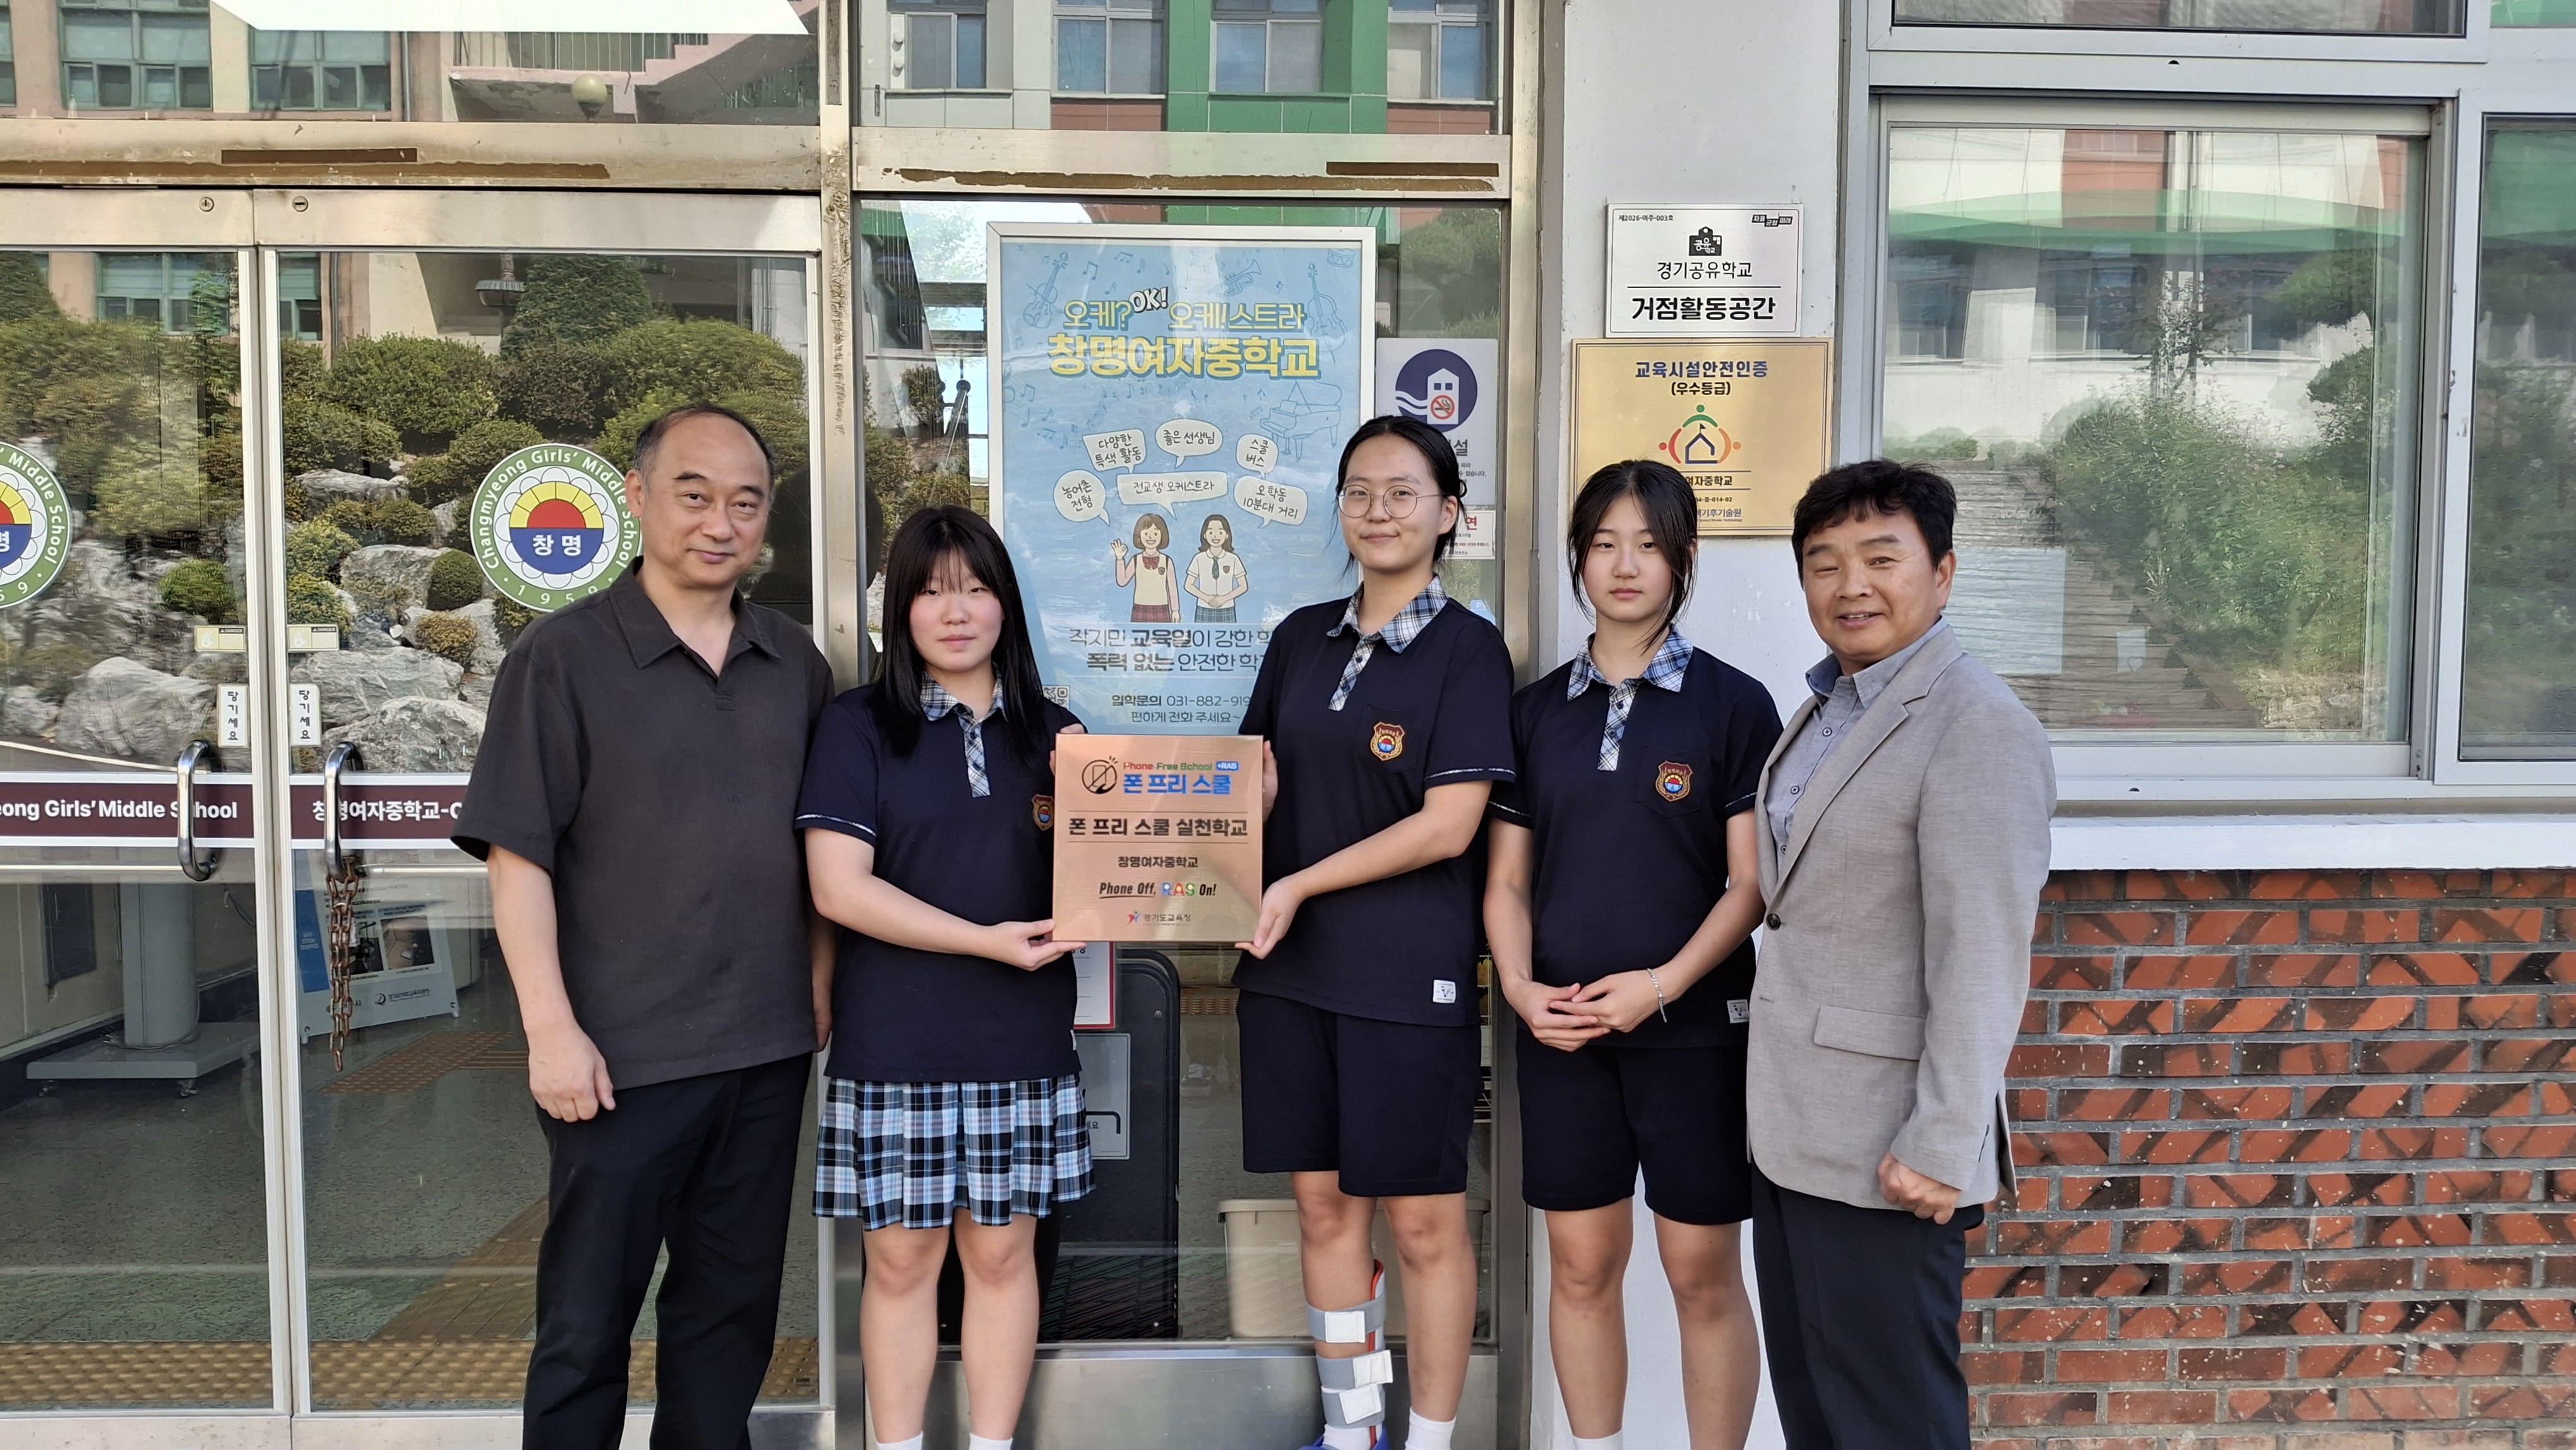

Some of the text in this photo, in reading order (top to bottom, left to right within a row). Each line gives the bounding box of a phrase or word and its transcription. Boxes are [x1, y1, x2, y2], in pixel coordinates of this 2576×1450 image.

[1693, 237, 1711, 251] 공유
[1656, 261, 1753, 280] 경기공유학교
[1063, 300, 1133, 330] 오케?
[1128, 286, 1169, 313] OK!
[1631, 297, 1776, 320] 거점활동공간
[1048, 332, 1320, 378] 창명여자중학교
[1635, 361, 1768, 378] 교육시설안전인증
[1671, 381, 1731, 396] (우수등급)
[1098, 433, 1132, 449] 다양한
[1163, 429, 1215, 446] 좋은 선생님
[1249, 439, 1269, 455] 스쿨
[1448, 439, 1468, 457] 설
[1095, 446, 1142, 468] 특색 활동
[1246, 453, 1265, 467] 버스
[1062, 479, 1092, 499] 농어촌
[1133, 480, 1215, 494] 전교생 오케스트라
[8, 452, 66, 564] Middle School
[1071, 494, 1093, 512] 전형
[1243, 497, 1298, 519] 10분대 거리
[479, 458, 528, 569] Changmyeong
[581, 456, 626, 505] Middle
[1069, 628, 1126, 647] 작지만
[1215, 629, 1254, 648] 강한
[1087, 652, 1265, 672] 폭력 없는 안전한 학
[1112, 695, 1162, 707] 입학문의
[227, 691, 239, 741] 당기세요
[298, 690, 311, 740] 당기세요
[1131, 712, 1166, 723] 편하게
[1168, 712, 1193, 723] 전화
[1123, 762, 1153, 770] Phone
[1156, 762, 1178, 770] Free
[1180, 762, 1212, 770] School
[1123, 774, 1231, 794] 폰 프리 스쿨
[98, 800, 165, 818] Middle
[170, 801, 237, 818] Shool
[1068, 818, 1248, 837] 폰 프리 스쿨 실천학교
[1118, 856, 1198, 868] 창명여자중학교
[1099, 882, 1217, 897] Phone Off, RAS On!
[1143, 914, 1191, 923] 경기도교육청
